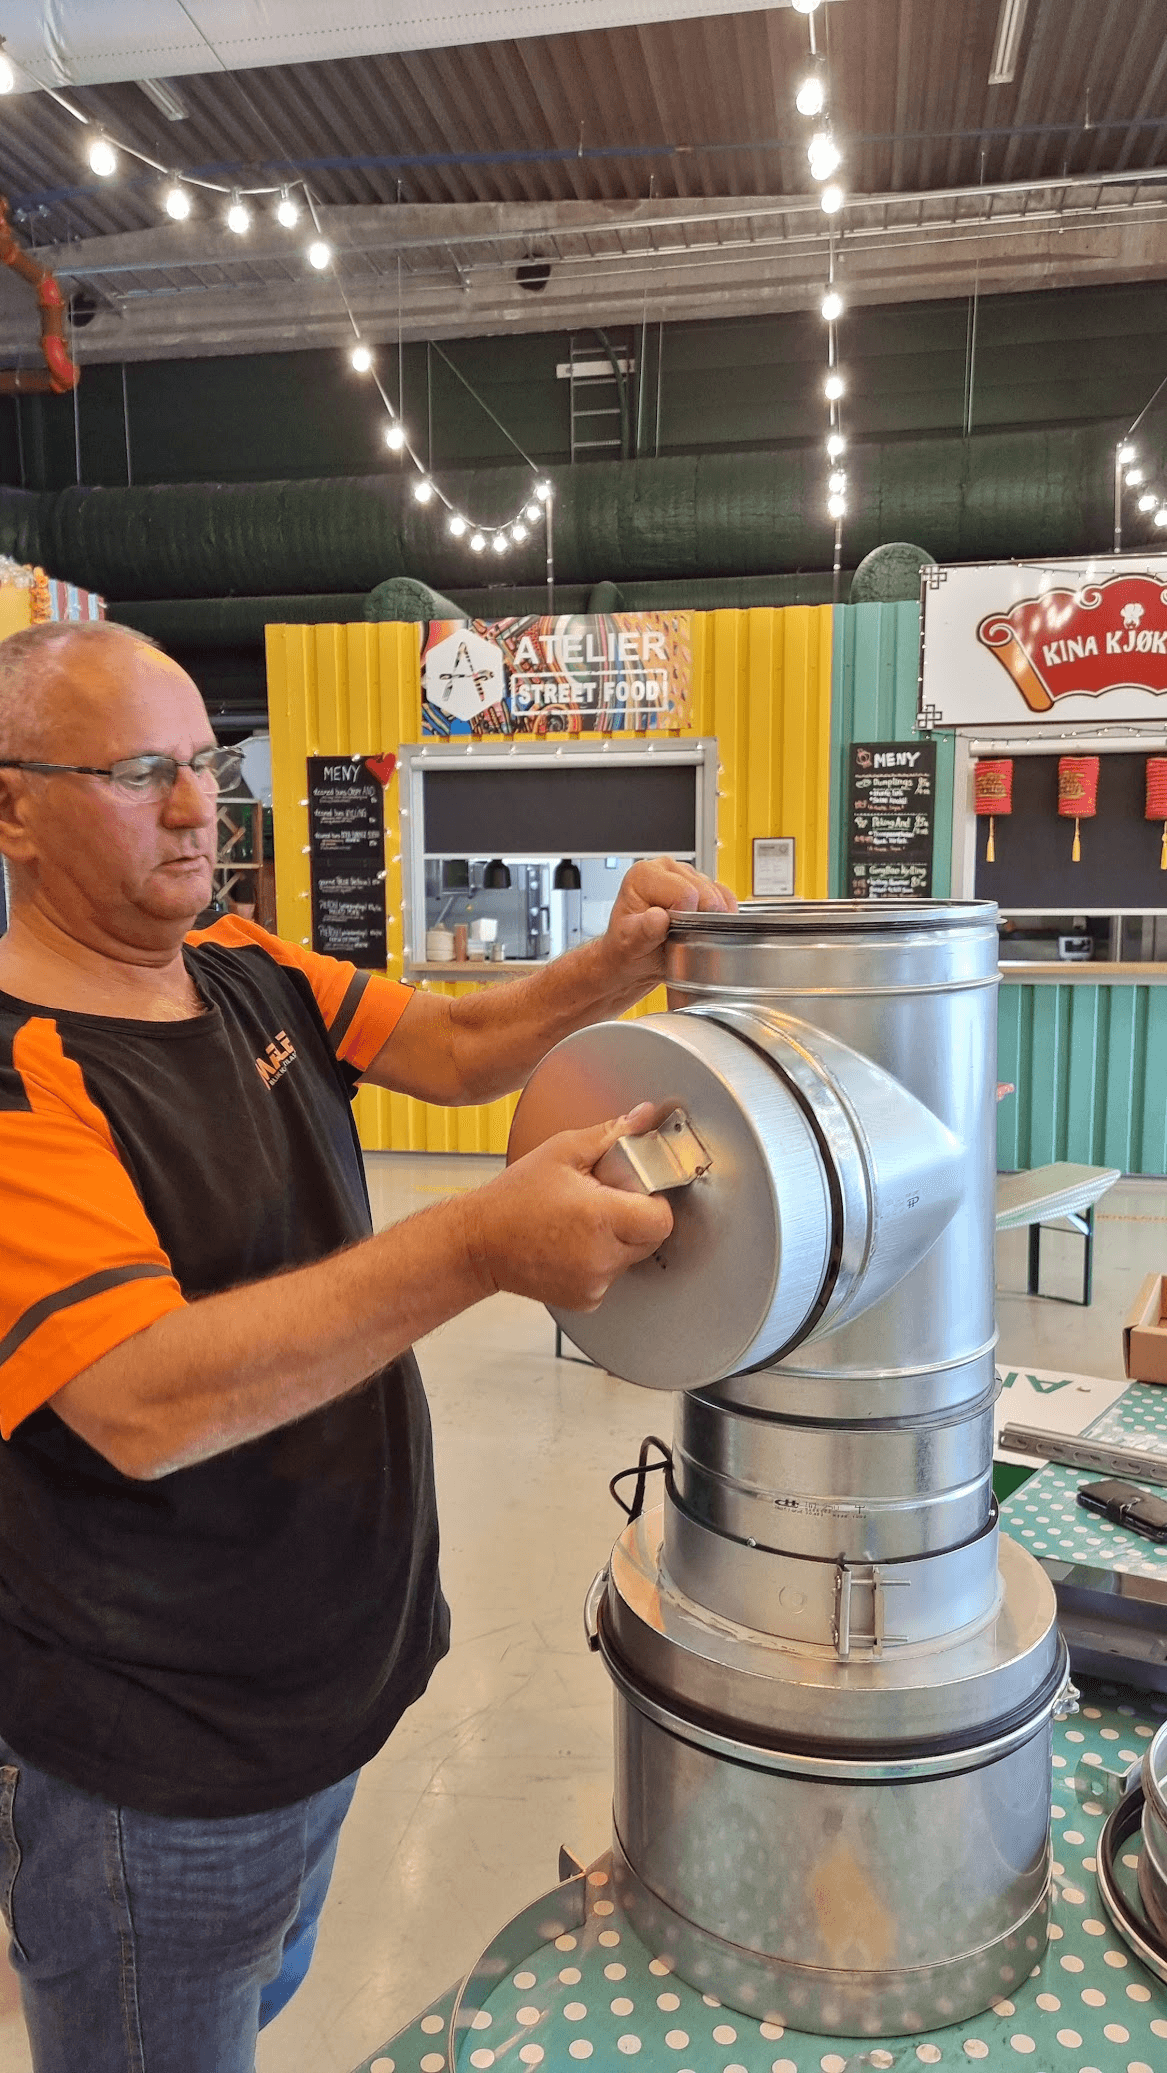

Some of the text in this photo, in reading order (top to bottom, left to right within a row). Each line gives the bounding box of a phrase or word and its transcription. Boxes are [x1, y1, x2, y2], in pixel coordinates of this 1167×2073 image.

[513, 631, 670, 665] ATELIER
[1042, 635, 1099, 667] KINA
[518, 680, 660, 704] STREET FOOD
[873, 751, 921, 769] MENY
[323, 764, 362, 783] MENY
[872, 777, 914, 788] Dumplings
